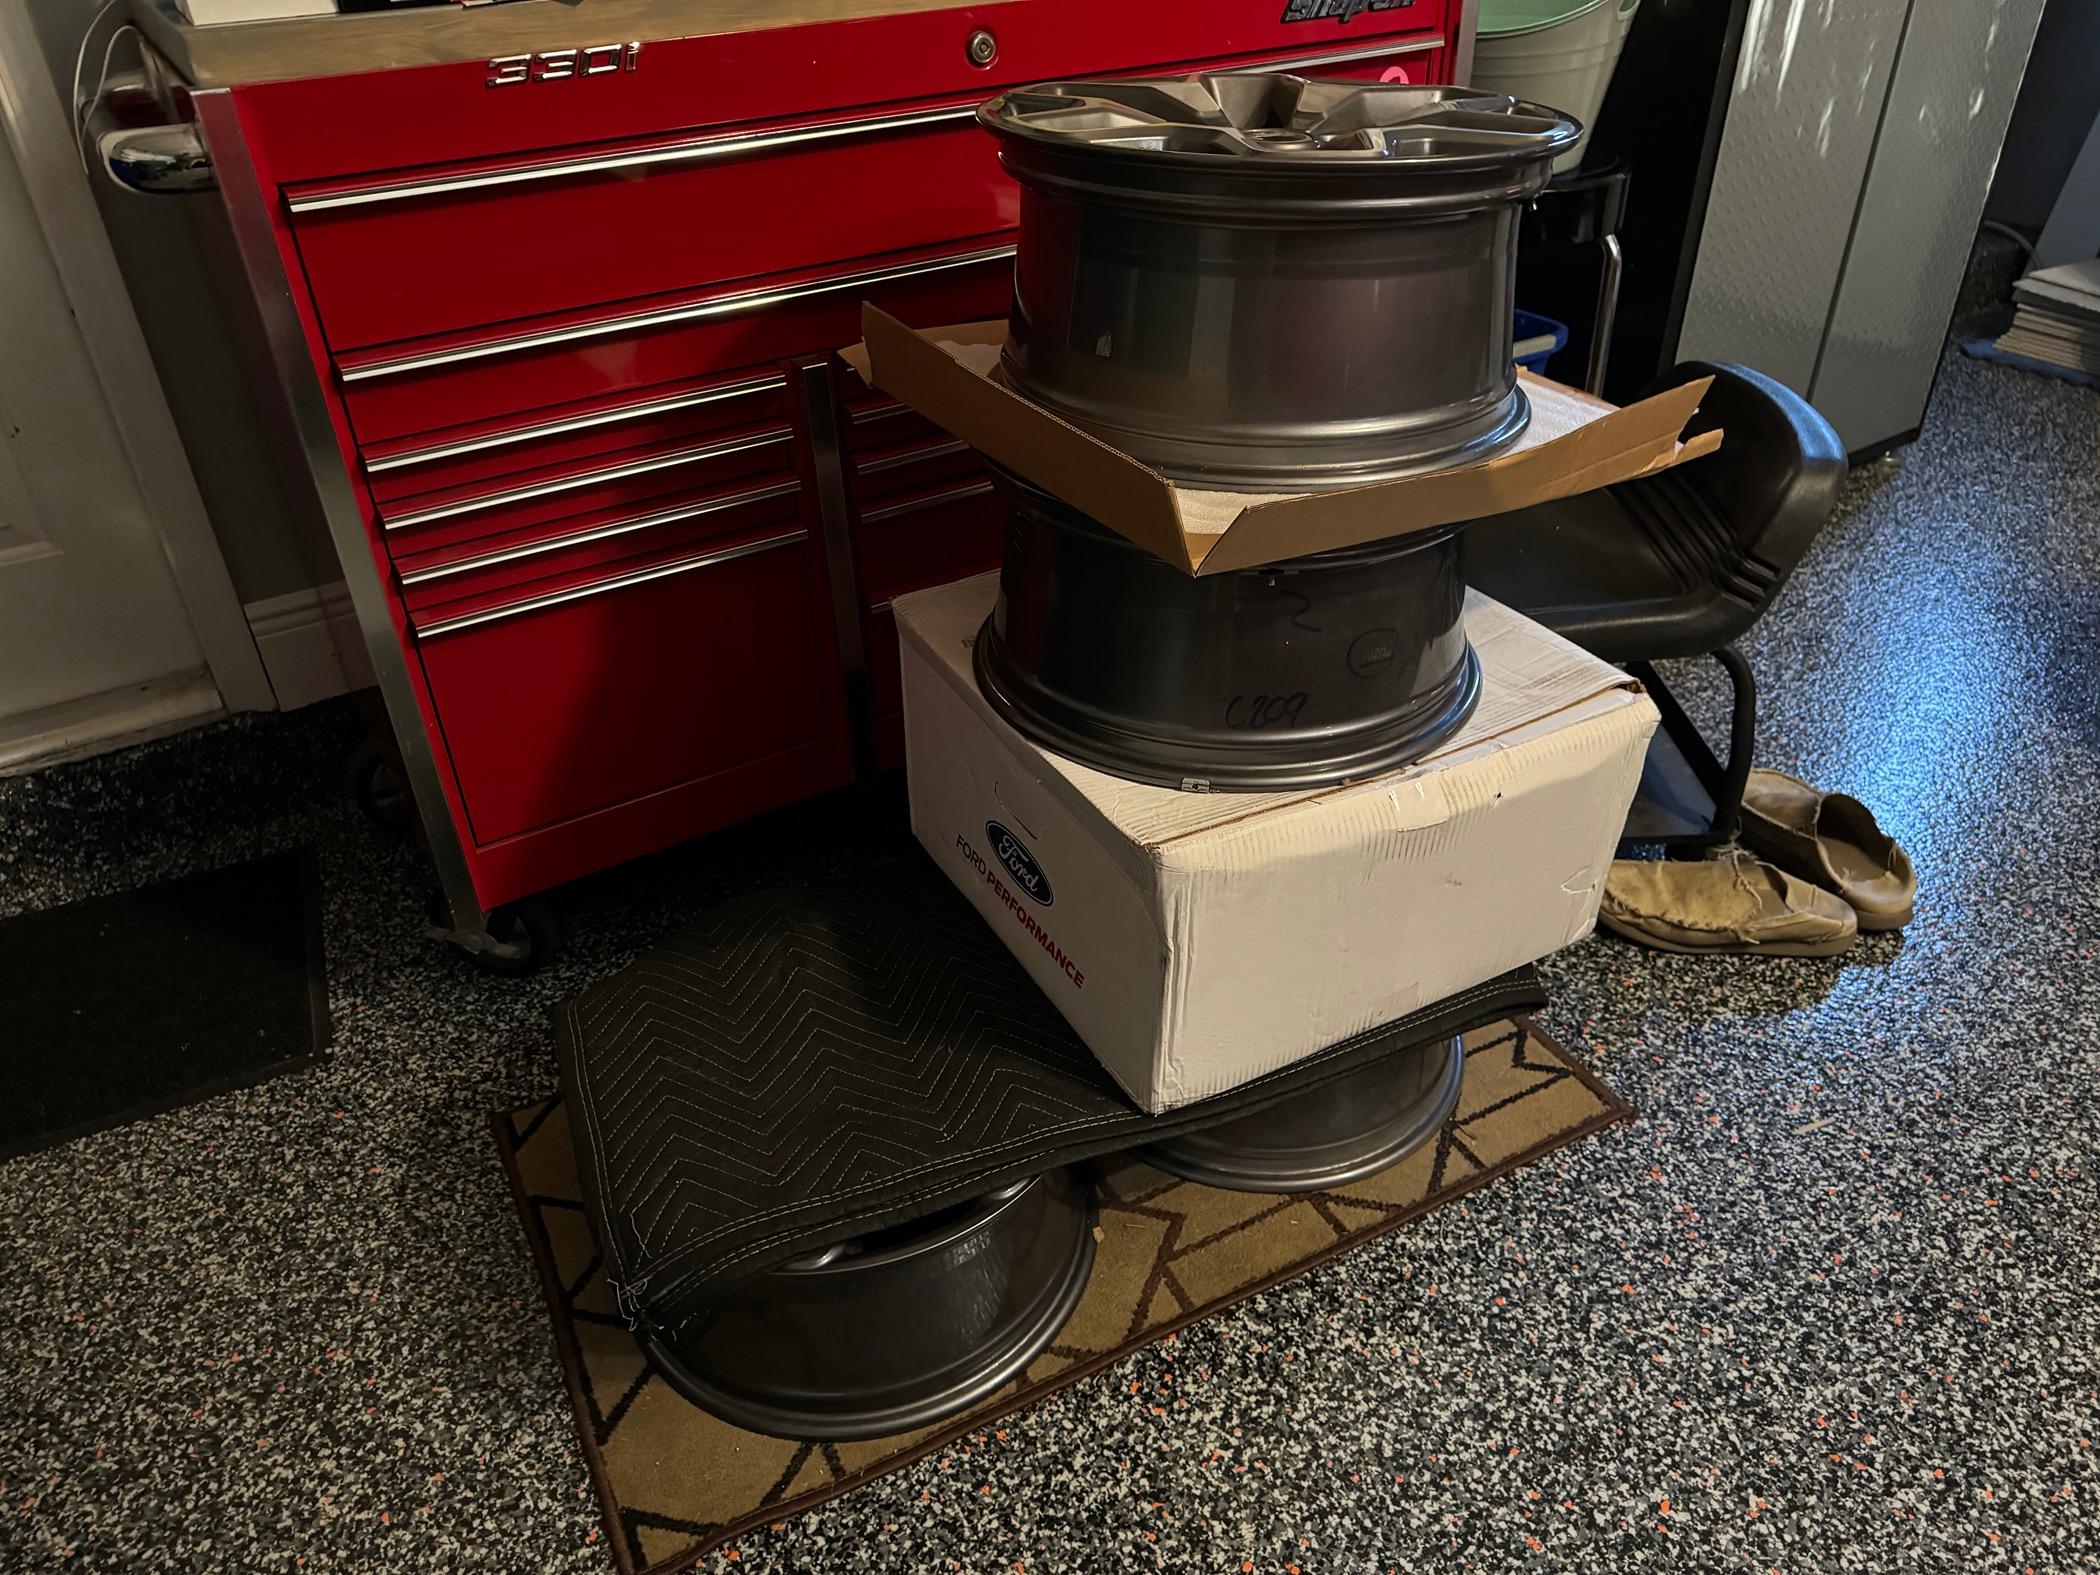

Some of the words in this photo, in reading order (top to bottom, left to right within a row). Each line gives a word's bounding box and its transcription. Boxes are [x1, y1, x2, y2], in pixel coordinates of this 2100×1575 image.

[486, 41, 641, 87] 330i
[998, 834, 1039, 892] Ford
[956, 834, 987, 875] FORD
[986, 869, 1085, 989] PERFORMANCE
